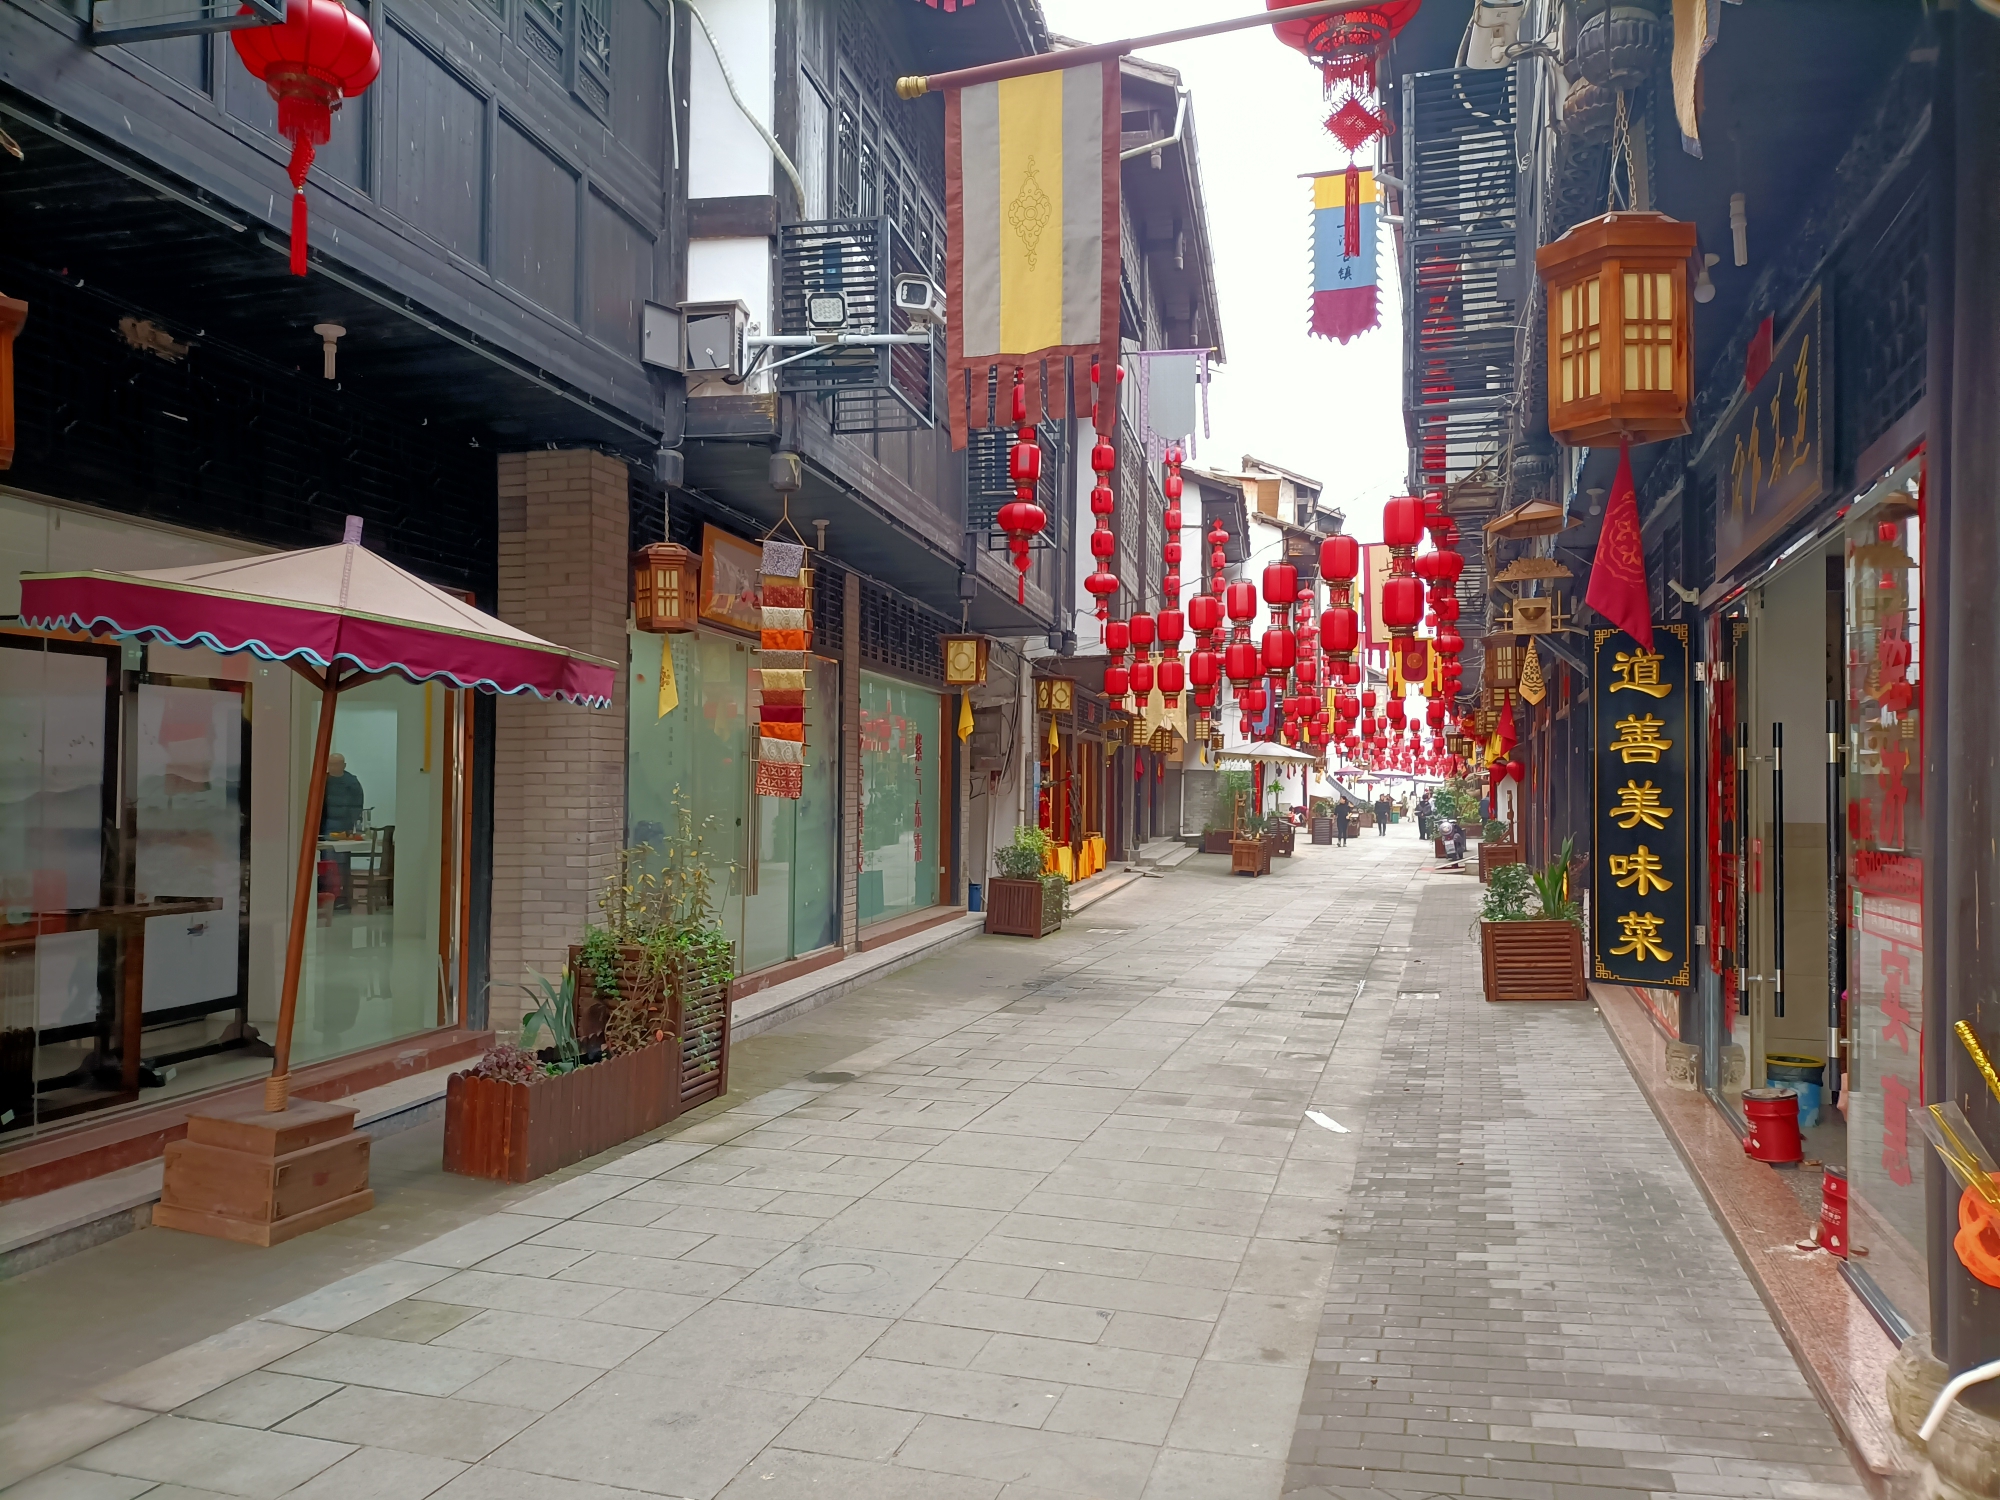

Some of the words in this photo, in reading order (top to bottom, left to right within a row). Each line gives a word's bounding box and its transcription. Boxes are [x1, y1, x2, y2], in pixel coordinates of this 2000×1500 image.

[1608, 646, 1674, 963] 道善美味菜
